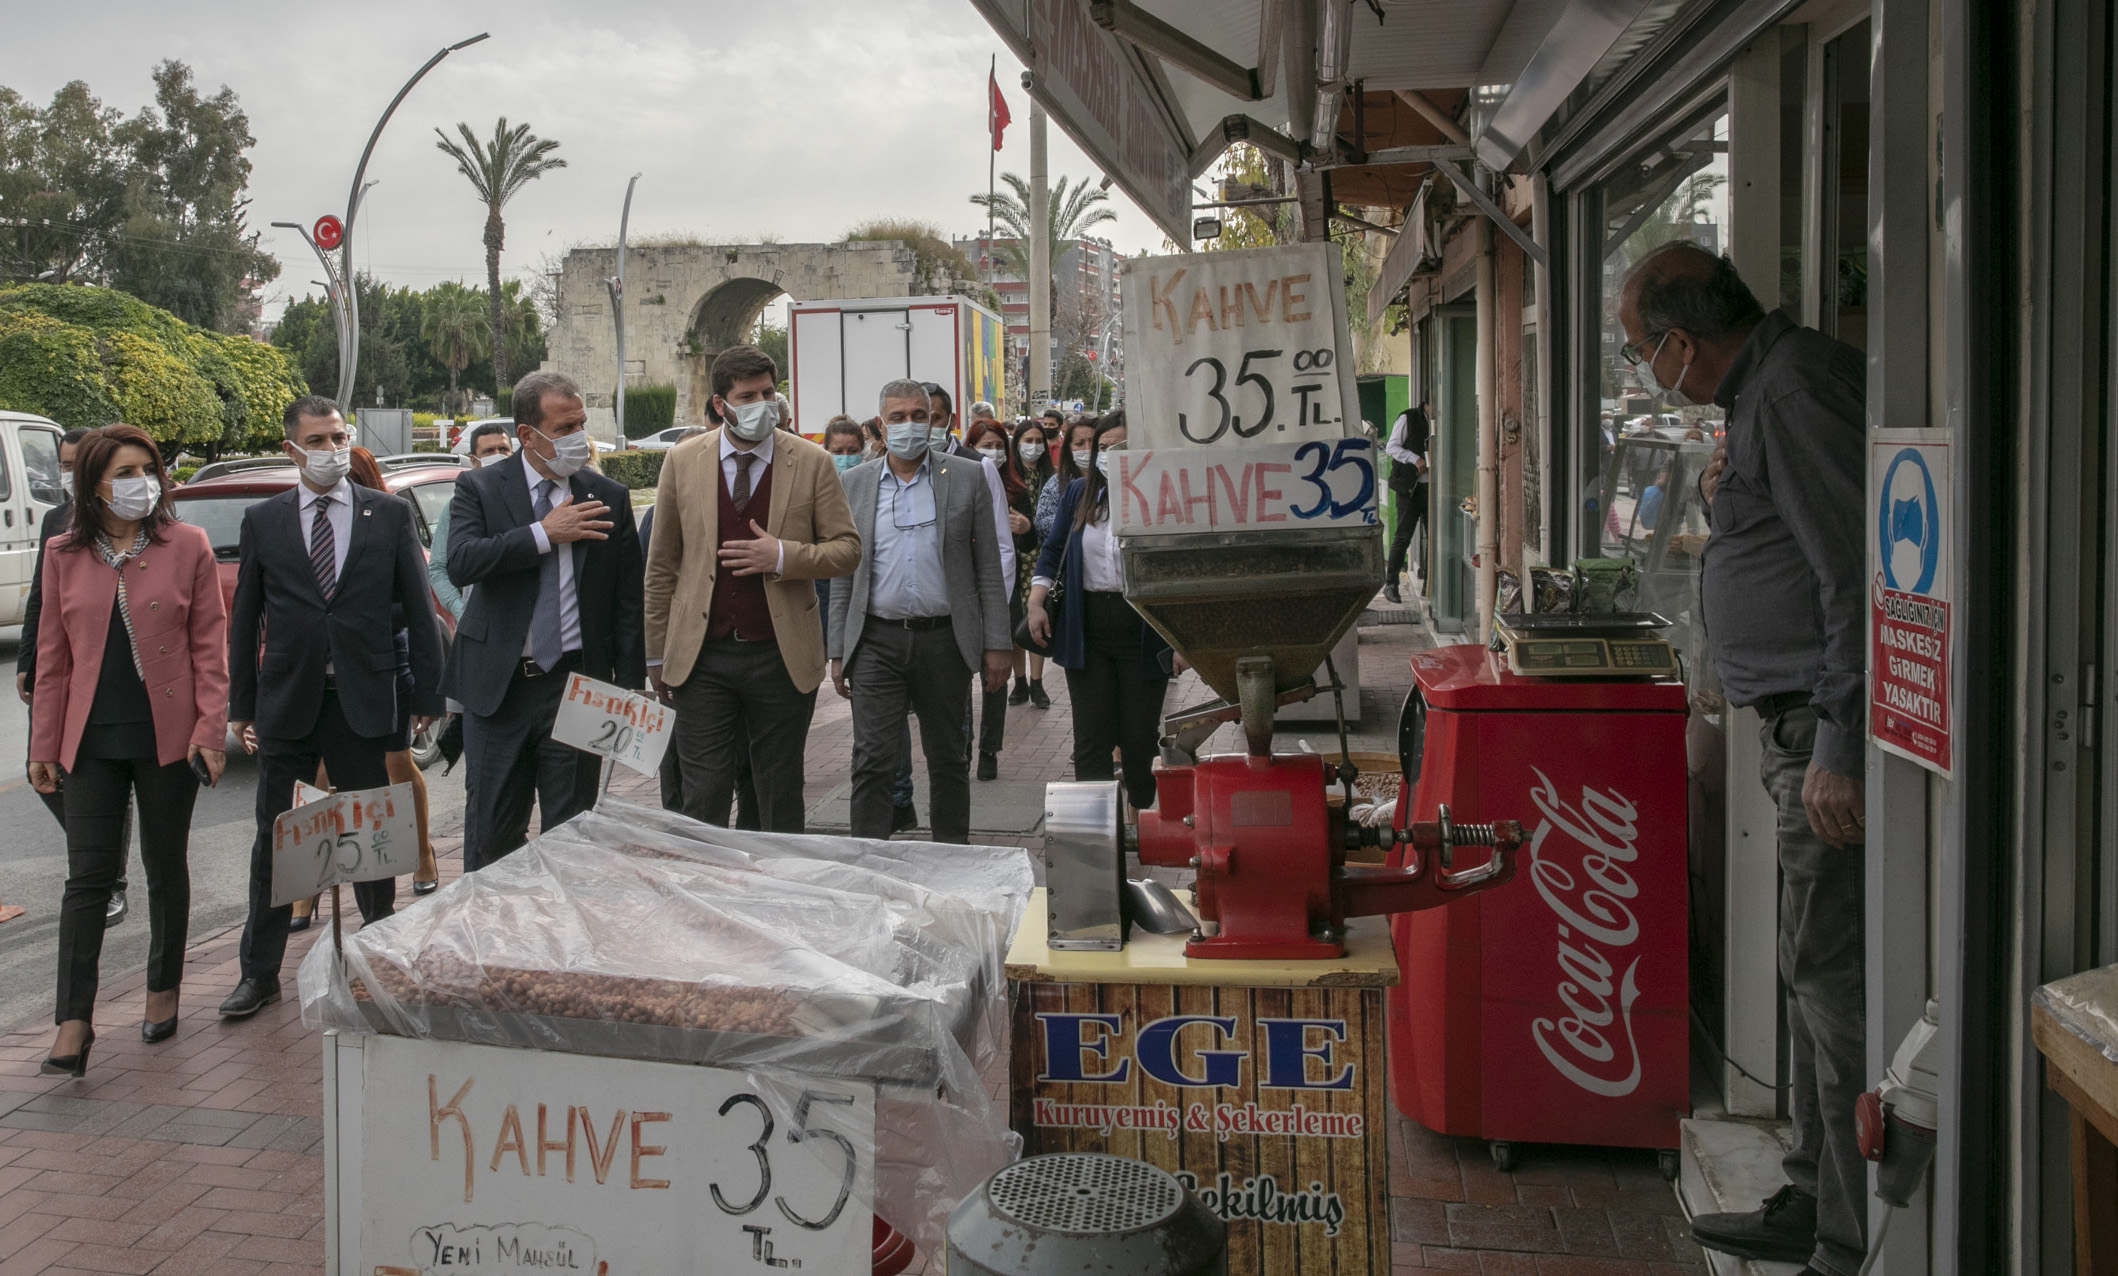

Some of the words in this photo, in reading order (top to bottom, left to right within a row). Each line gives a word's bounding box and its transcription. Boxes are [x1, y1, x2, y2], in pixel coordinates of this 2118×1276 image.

[1151, 268, 1311, 345] KAHVE
[1119, 452, 1292, 527] KAHVE
[1290, 438, 1375, 520] 35
[1880, 624, 1942, 662] MASKESİZ
[1889, 655, 1936, 691] GİRMEK
[1882, 681, 1941, 725] YASAKTIR
[1035, 1012, 1355, 1091] EGE
[1034, 1098, 1181, 1138] Kuruyemiş
[1186, 1105, 1208, 1131] &
[1217, 1104, 1363, 1141] Şekerleme
[427, 1073, 673, 1204] KAHVE
[709, 1092, 856, 1231] 35
[1175, 1171, 1343, 1238] ekilmiş
[424, 1231, 481, 1266] YENİ
[496, 1236, 580, 1269] MAHSÜL
